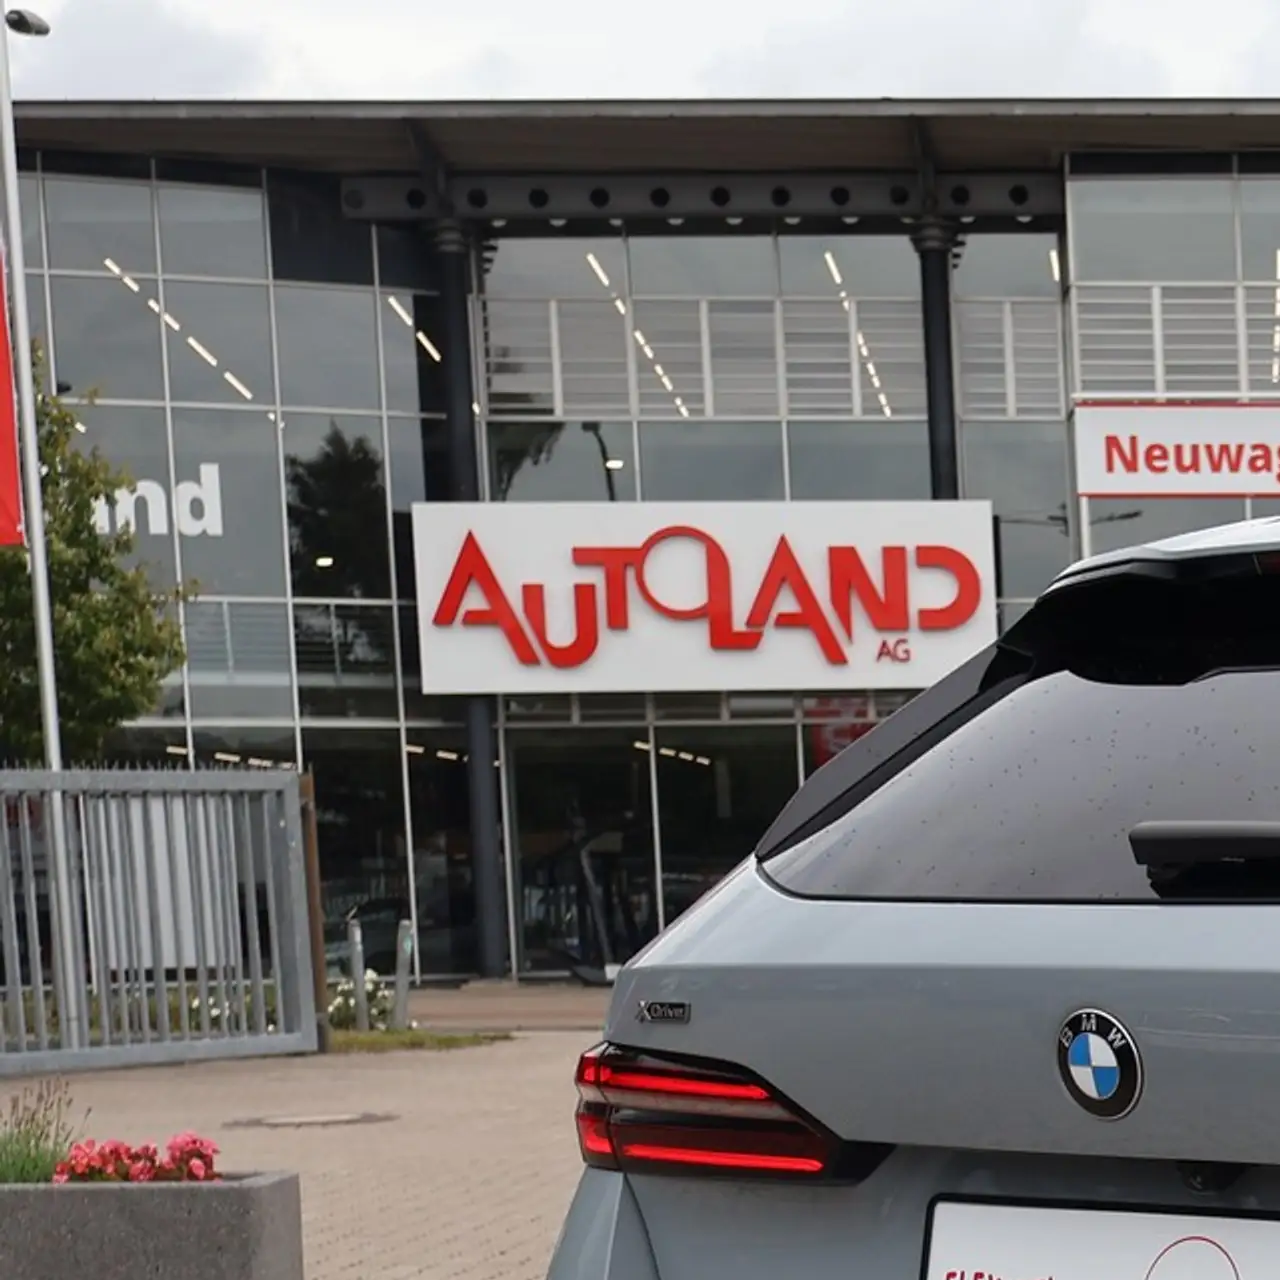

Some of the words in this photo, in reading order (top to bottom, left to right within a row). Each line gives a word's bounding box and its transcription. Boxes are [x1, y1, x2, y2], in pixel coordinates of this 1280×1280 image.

[432, 524, 983, 669] AUTOLAND
[875, 638, 912, 663] AG
[1060, 1013, 1127, 1048] BMW
